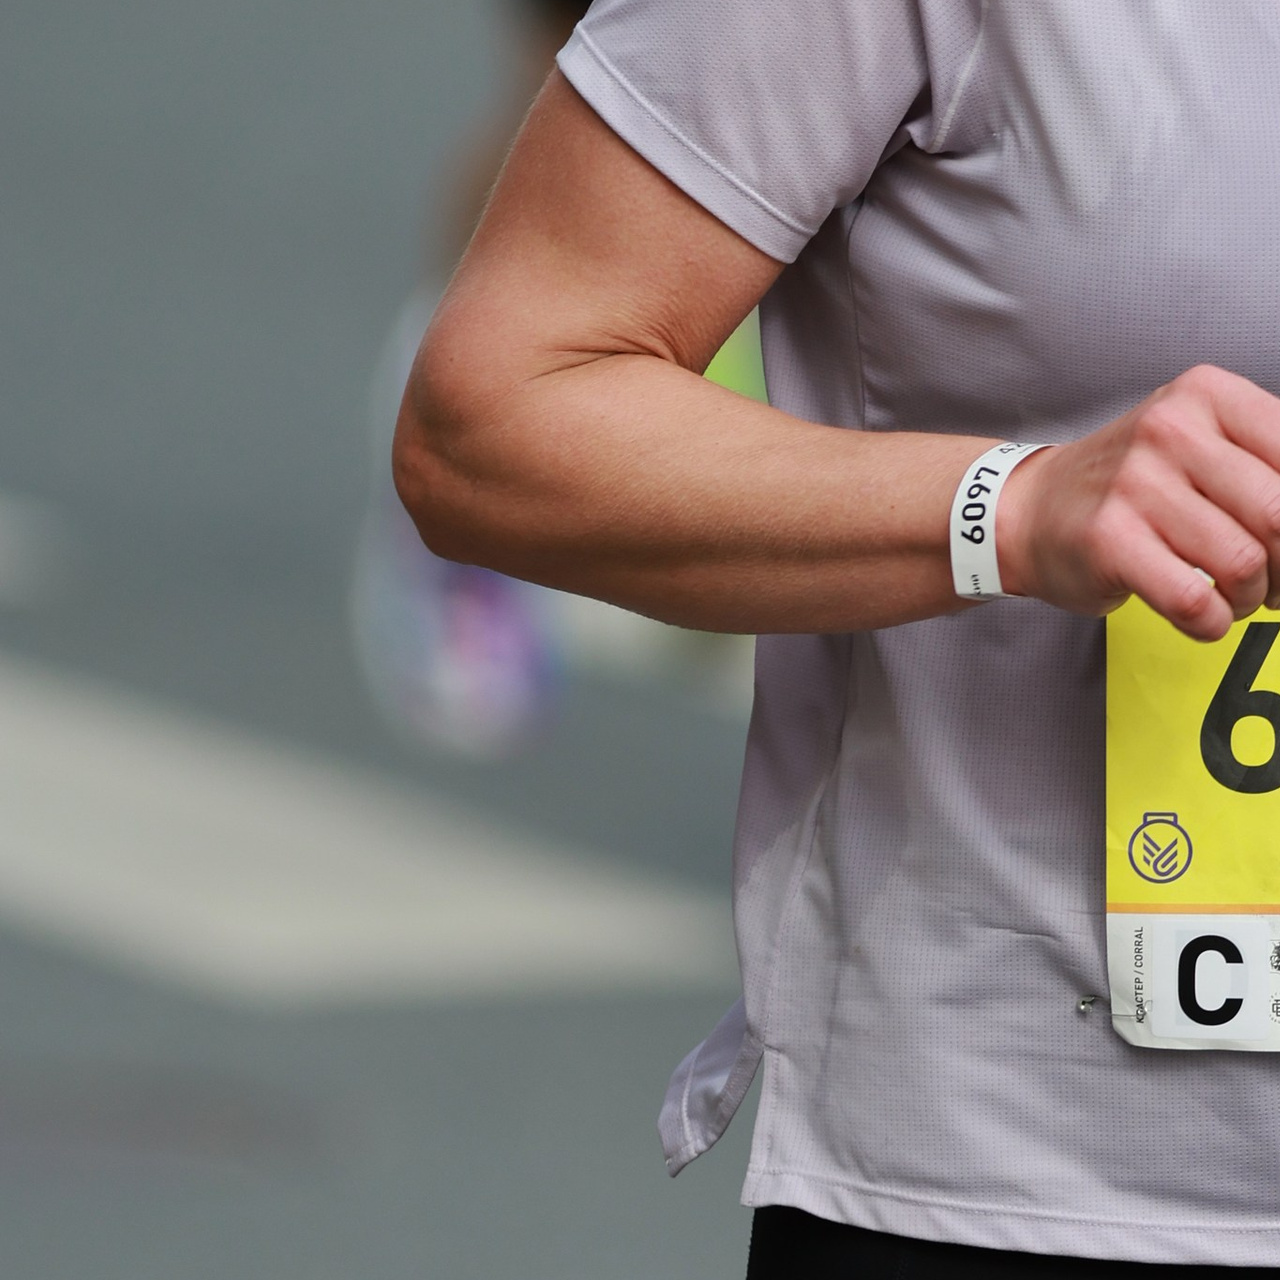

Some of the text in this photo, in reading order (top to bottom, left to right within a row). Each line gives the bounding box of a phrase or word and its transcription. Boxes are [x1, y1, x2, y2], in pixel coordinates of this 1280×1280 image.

[960, 466, 1001, 545] 6097
[1134, 926, 1144, 968] CORRAL
[1177, 934, 1244, 1026] C
